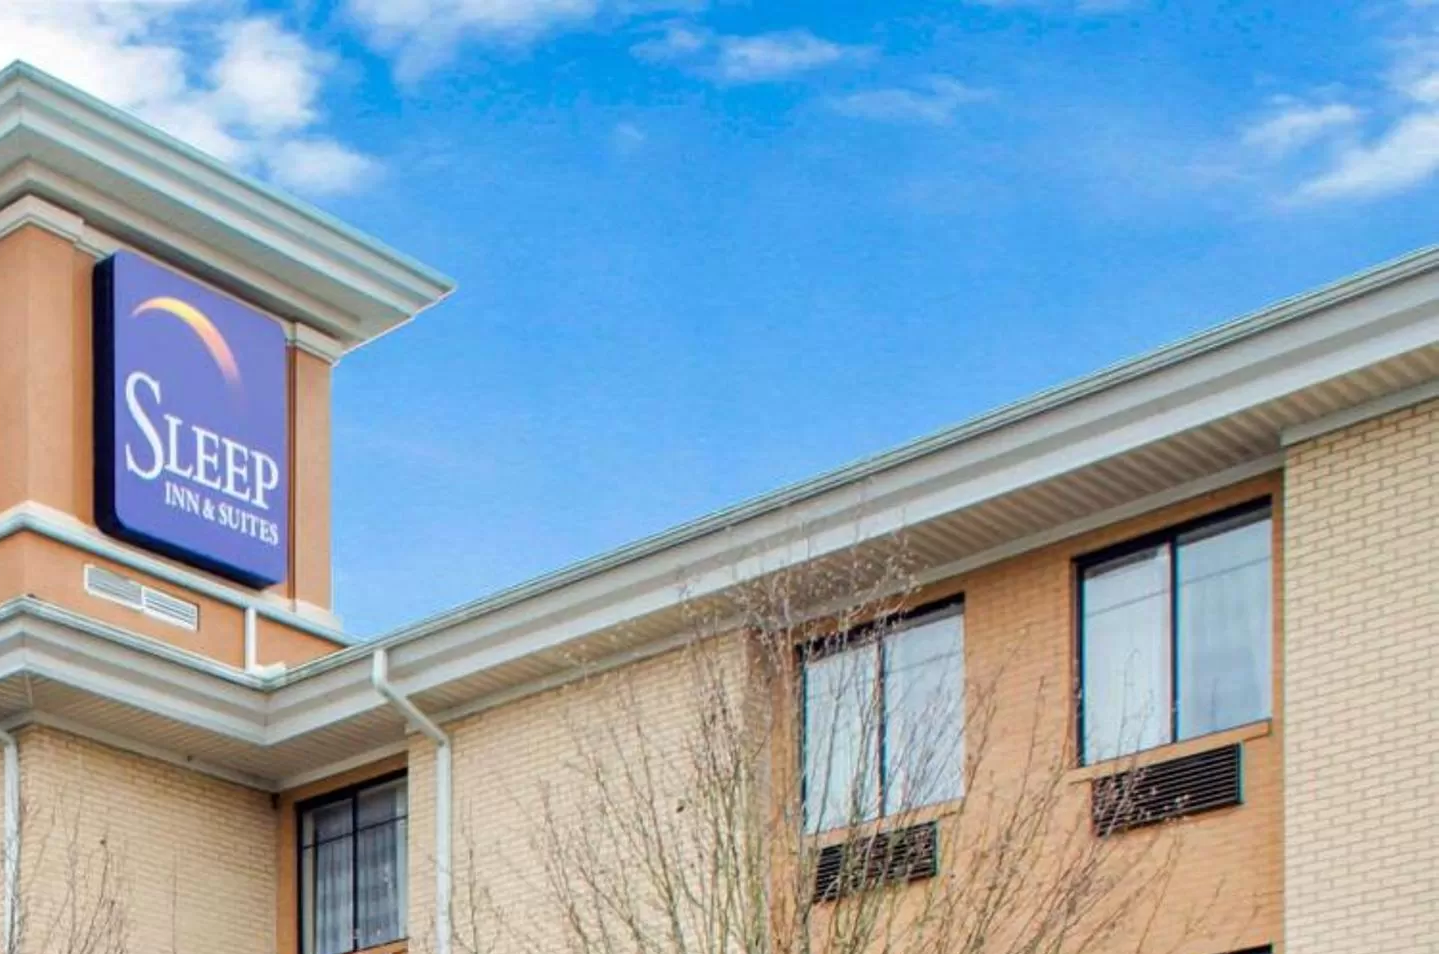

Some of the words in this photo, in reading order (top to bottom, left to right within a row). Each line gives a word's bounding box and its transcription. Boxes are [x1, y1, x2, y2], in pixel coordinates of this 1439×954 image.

[125, 371, 279, 510] SLEEP
[164, 480, 201, 517] INN
[202, 498, 215, 521] &
[218, 502, 279, 546] SUITES
